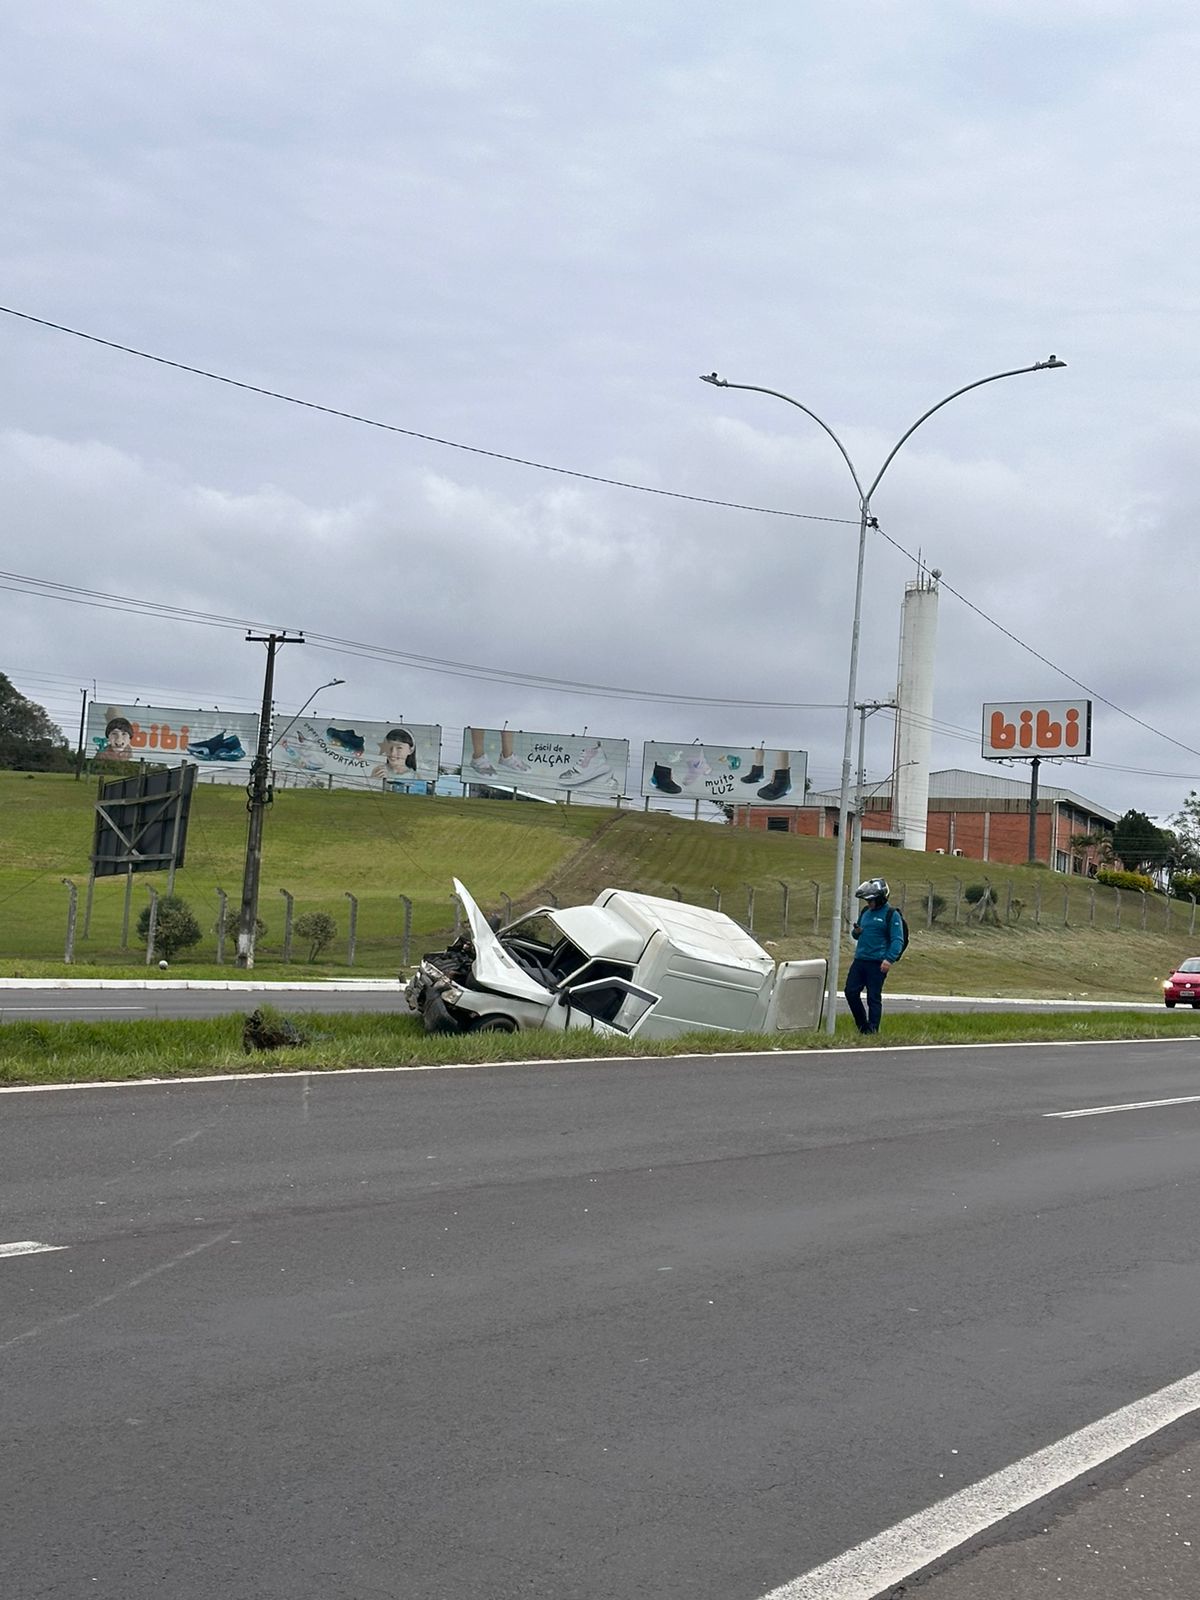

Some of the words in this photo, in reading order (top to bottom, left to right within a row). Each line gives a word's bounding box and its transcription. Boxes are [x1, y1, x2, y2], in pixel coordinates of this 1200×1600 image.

[130, 722, 190, 750] bibi
[990, 709, 1080, 750] bibi
[553, 743, 564, 753] de
[527, 752, 571, 768] CALÇAR
[705, 774, 735, 787] muita
[712, 783, 734, 795] LUZ
